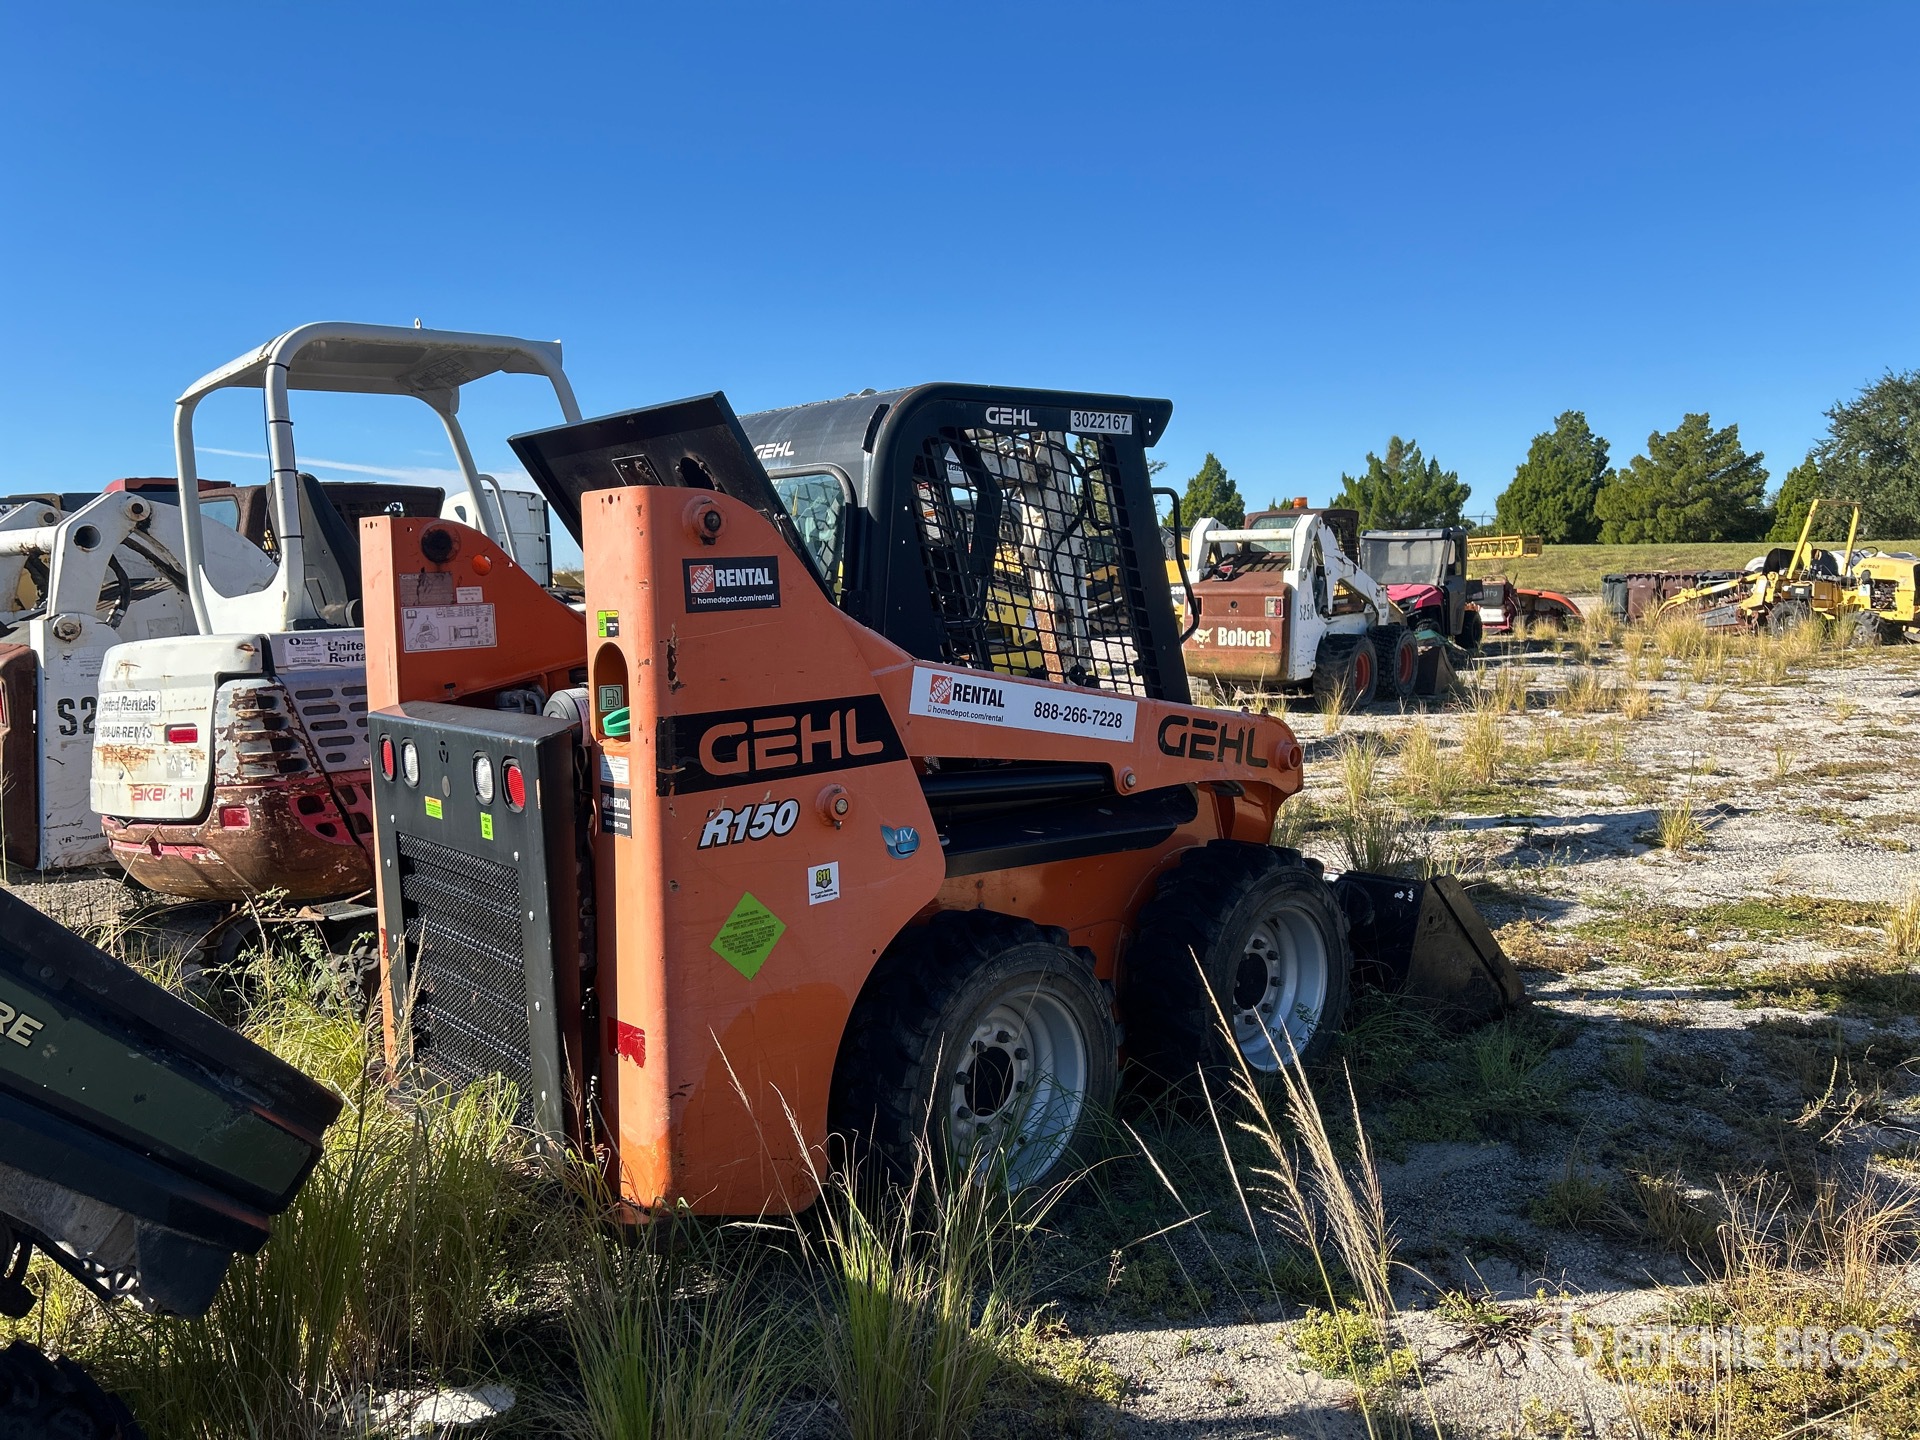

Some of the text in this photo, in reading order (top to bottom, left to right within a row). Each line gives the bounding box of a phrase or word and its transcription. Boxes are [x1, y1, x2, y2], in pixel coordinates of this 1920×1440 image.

[986, 407, 1038, 426] GEHL
[1074, 412, 1128, 430] 3022167
[754, 441, 794, 459] GEHL
[691, 565, 714, 592] HOME
[715, 568, 774, 587] RENTAL
[698, 594, 774, 604] homedepot.com/rental
[328, 641, 365, 652] Unite
[1218, 627, 1272, 647] Bobcat
[930, 676, 952, 702] HOME
[121, 695, 156, 712] Rentals
[952, 683, 1122, 728] RENTAL 888-266-7228
[932, 706, 1004, 722] homedepot.com/rental
[698, 708, 884, 776] GEHL
[1158, 714, 1268, 768] GEHL
[698, 798, 800, 849] R150
[900, 828, 914, 842] IV
[816, 868, 831, 882] 811
